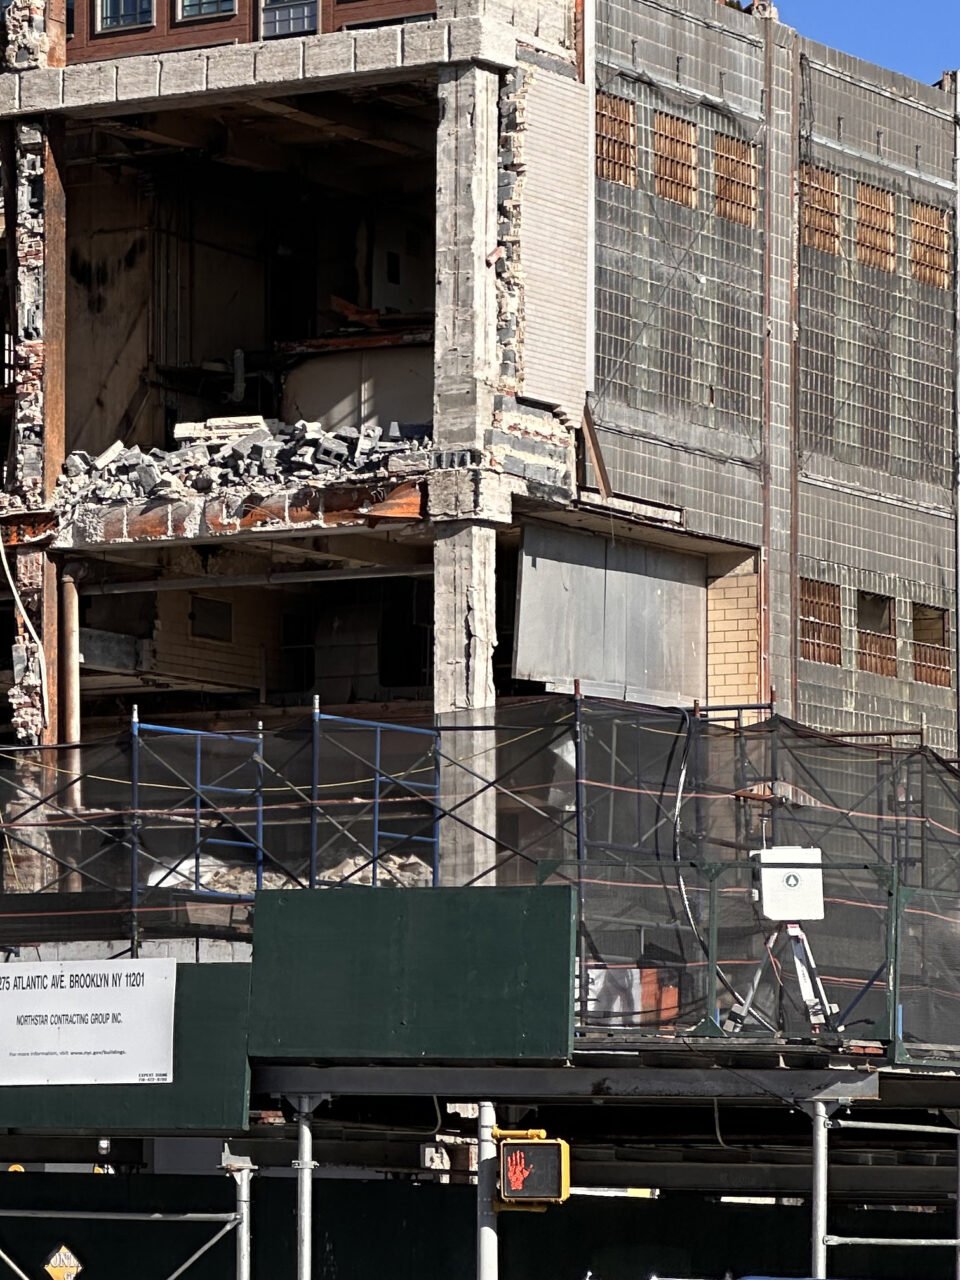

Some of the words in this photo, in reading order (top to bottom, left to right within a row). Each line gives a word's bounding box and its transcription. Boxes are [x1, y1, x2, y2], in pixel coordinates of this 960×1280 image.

[13, 975, 48, 990] ATLANTIC
[51, 974, 66, 989] AVE.
[69, 973, 109, 988] BROOKLYN
[111, 973, 122, 987] NY
[125, 972, 145, 987] 11201
[16, 1014, 48, 1025] NORTHSTAR
[50, 1013, 88, 1025] CONTRACTING
[90, 1013, 110, 1024] GROUP
[111, 1012, 123, 1023] INC.
